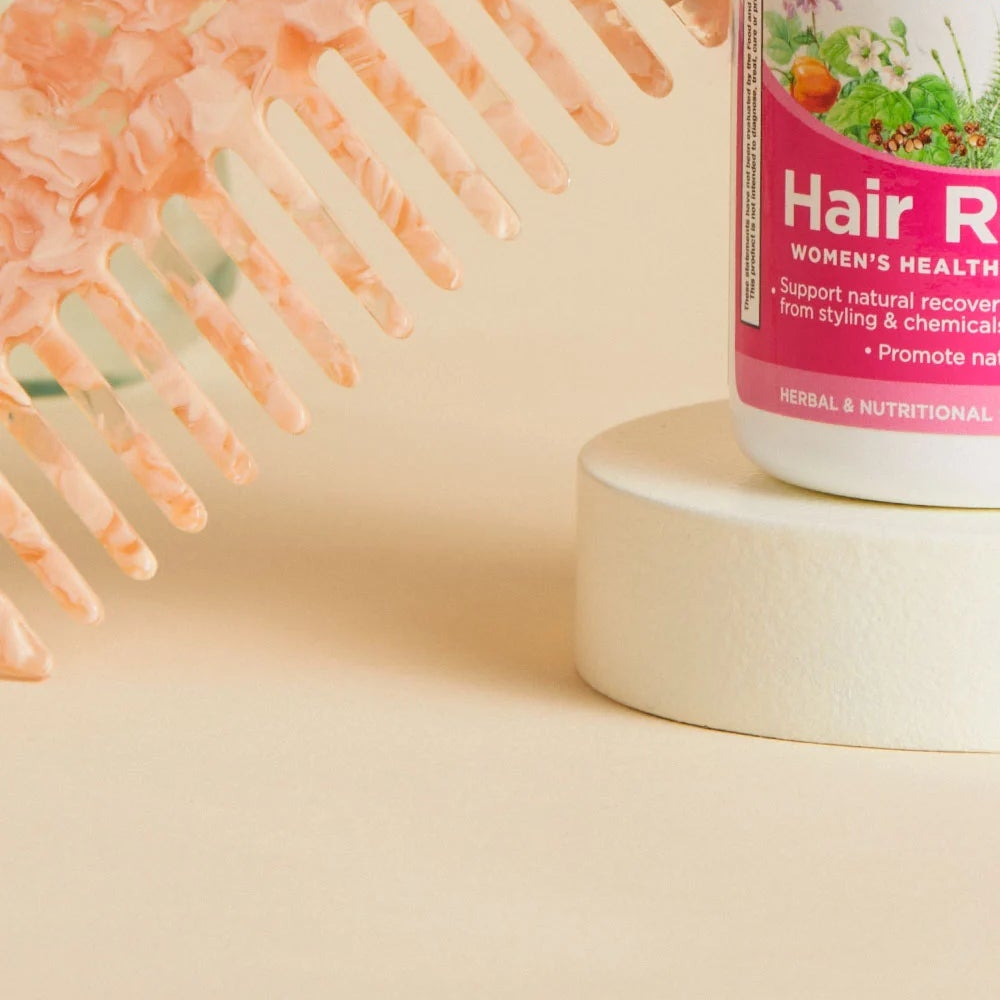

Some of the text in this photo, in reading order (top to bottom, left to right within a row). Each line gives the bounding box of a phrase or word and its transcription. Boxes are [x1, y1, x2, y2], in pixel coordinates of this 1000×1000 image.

[784, 169, 914, 240] Hair
[791, 242, 891, 272] WOMEN'S
[780, 276, 843, 303] Support
[848, 289, 914, 312] natural
[779, 296, 814, 320] from
[819, 306, 878, 331] styling
[883, 311, 898, 330] &
[878, 343, 966, 366] Promote
[780, 387, 839, 411] HERBAL
[842, 397, 855, 413] &
[860, 399, 995, 423] NUTRITIONAL
